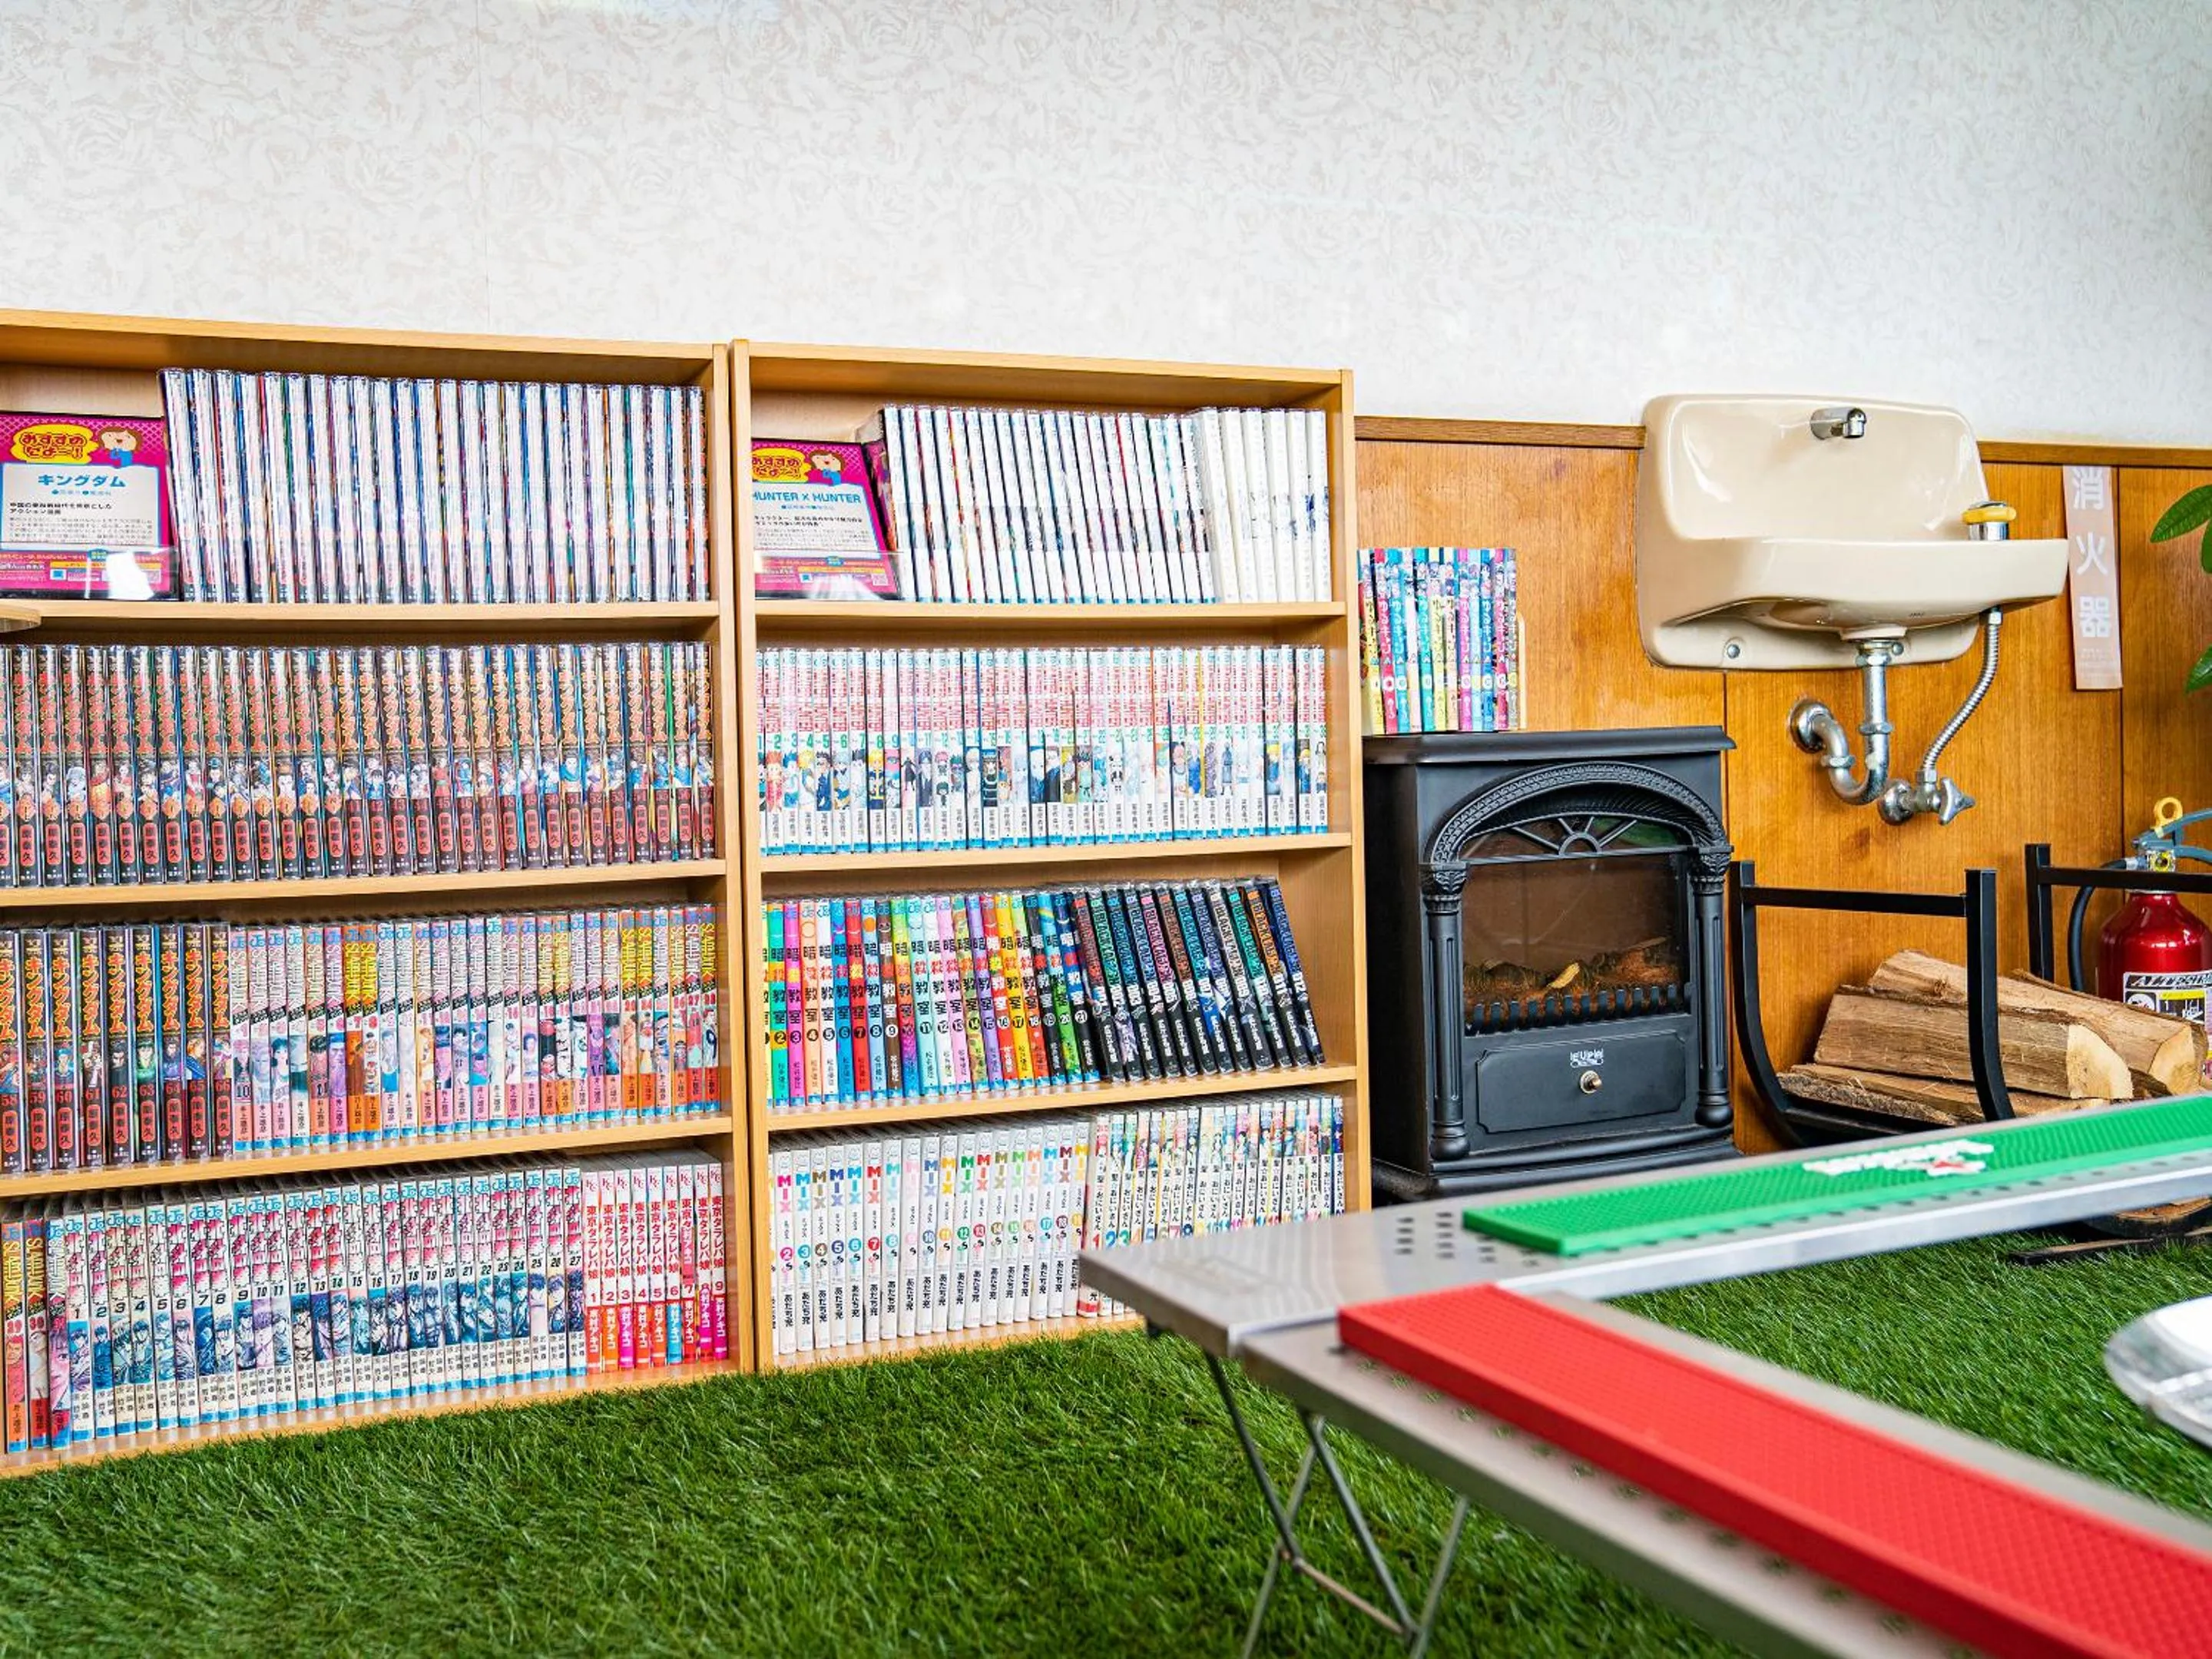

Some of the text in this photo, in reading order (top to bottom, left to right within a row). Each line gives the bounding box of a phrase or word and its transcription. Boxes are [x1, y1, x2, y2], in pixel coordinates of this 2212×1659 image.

[38, 475, 126, 488] キングダム
[813, 493, 861, 504] HUNTER
[2073, 466, 2110, 637] 消火器
[81, 954, 101, 1036] キングダム
[108, 952, 127, 1034] キングダム
[134, 951, 154, 1032] キングダム
[161, 951, 180, 1030] キングダム
[186, 949, 205, 1028] キングダム
[212, 949, 230, 1028] キングダム
[26, 956, 45, 1038] キングダム
[52, 956, 72, 1038] キングダム
[995, 1152, 1008, 1188] MIX
[1012, 1151, 1025, 1187] MIX
[1045, 1148, 1057, 1184] MIX
[1060, 1147, 1072, 1183] MIX
[925, 1160, 938, 1197] MIX
[942, 1157, 955, 1194] MIX
[961, 1156, 974, 1193] MIX
[977, 1154, 991, 1191] MIX
[830, 1169, 844, 1207] MIX
[848, 1167, 862, 1204] MIX
[867, 1167, 881, 1204] MIX
[886, 1164, 899, 1200] MIX
[777, 1174, 791, 1213] MIX
[796, 1174, 810, 1211] MIX
[813, 1171, 826, 1210] MIX
[651, 1201, 662, 1274] 東京タラレバ娘
[667, 1200, 678, 1273] 東京タラレバ娘
[698, 1197, 710, 1270] 東京タラレバ娘
[712, 1195, 724, 1268] 東京タラレバ娘
[587, 1205, 598, 1279] 東京タラレバ娘
[604, 1204, 614, 1279] 東京タラレバ娘
[619, 1203, 630, 1277] 東京タラレバ娘
[635, 1202, 647, 1276] 東京タラレバ娘
[531, 1258, 542, 1268] 25
[569, 1256, 580, 1266] 27
[409, 1271, 419, 1282] 18
[426, 1270, 436, 1280] 19
[462, 1267, 472, 1277] 21
[481, 1265, 491, 1275] 22
[333, 1278, 343, 1289] 14
[353, 1276, 363, 1286] 15
[372, 1277, 382, 1287] 16
[392, 1274, 402, 1284] 17
[257, 1287, 267, 1297] 10
[274, 1286, 283, 1296] 11
[296, 1282, 306, 1293] 12
[316, 1281, 326, 1292] 13
[670, 1286, 678, 1296] 6
[684, 1283, 693, 1293] 7
[715, 1281, 724, 1291] 9
[215, 1293, 226, 1305] 8
[238, 1290, 248, 1300] 9
[591, 1293, 597, 1303] 1
[606, 1292, 614, 1301] 2
[622, 1290, 630, 1300] 3
[638, 1289, 647, 1298] 4
[654, 1288, 662, 1298] 5
[135, 1300, 145, 1311] 4
[157, 1298, 167, 1309] 5
[176, 1299, 186, 1310] 6
[198, 1295, 209, 1306] 7
[97, 1306, 107, 1317] 2
[115, 1302, 125, 1313] 3
[75, 1310, 80, 1319] 1
